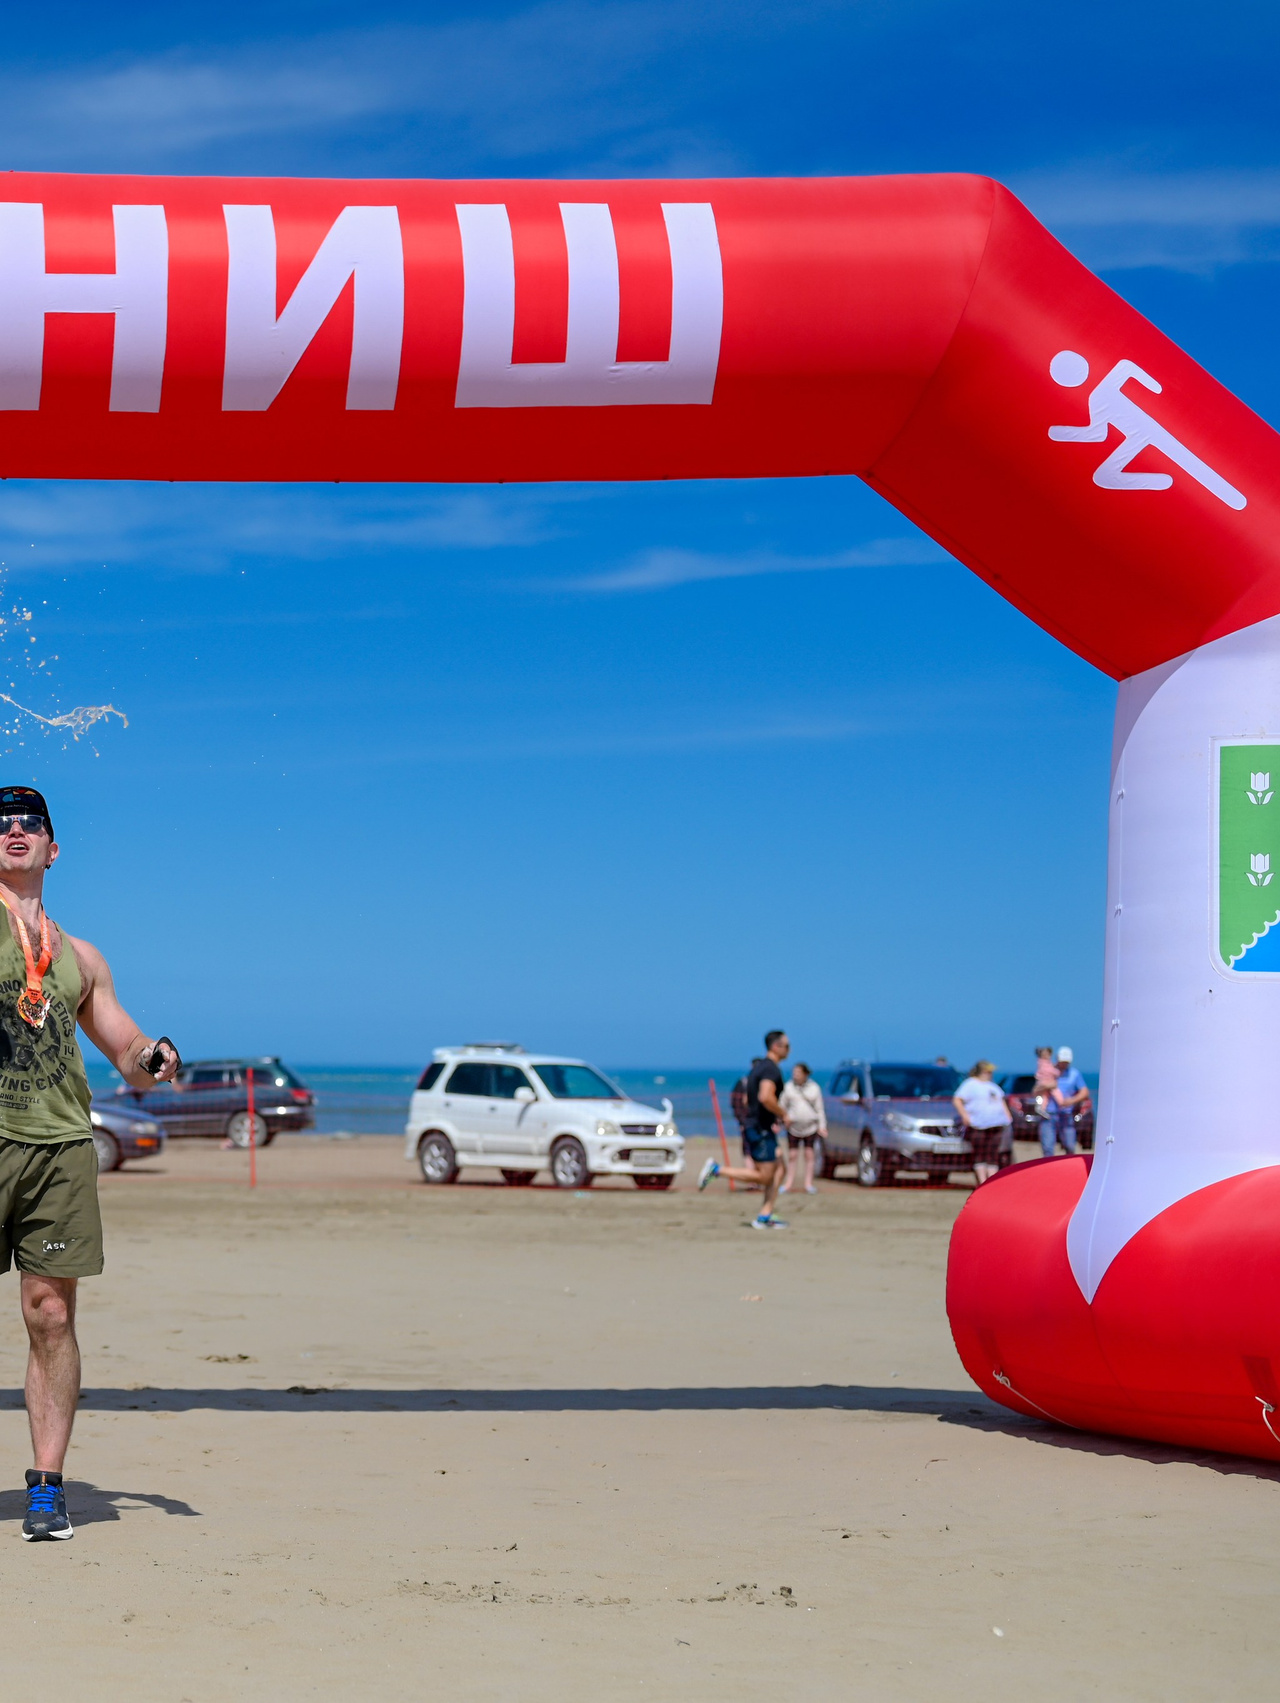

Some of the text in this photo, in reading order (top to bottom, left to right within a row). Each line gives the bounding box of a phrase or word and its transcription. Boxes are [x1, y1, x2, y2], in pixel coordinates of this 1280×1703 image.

[42, 990, 73, 1038] LETICS
[63, 1045, 75, 1057] 14
[35, 1062, 68, 1091] CAMP
[19, 1096, 40, 1104] STYLE
